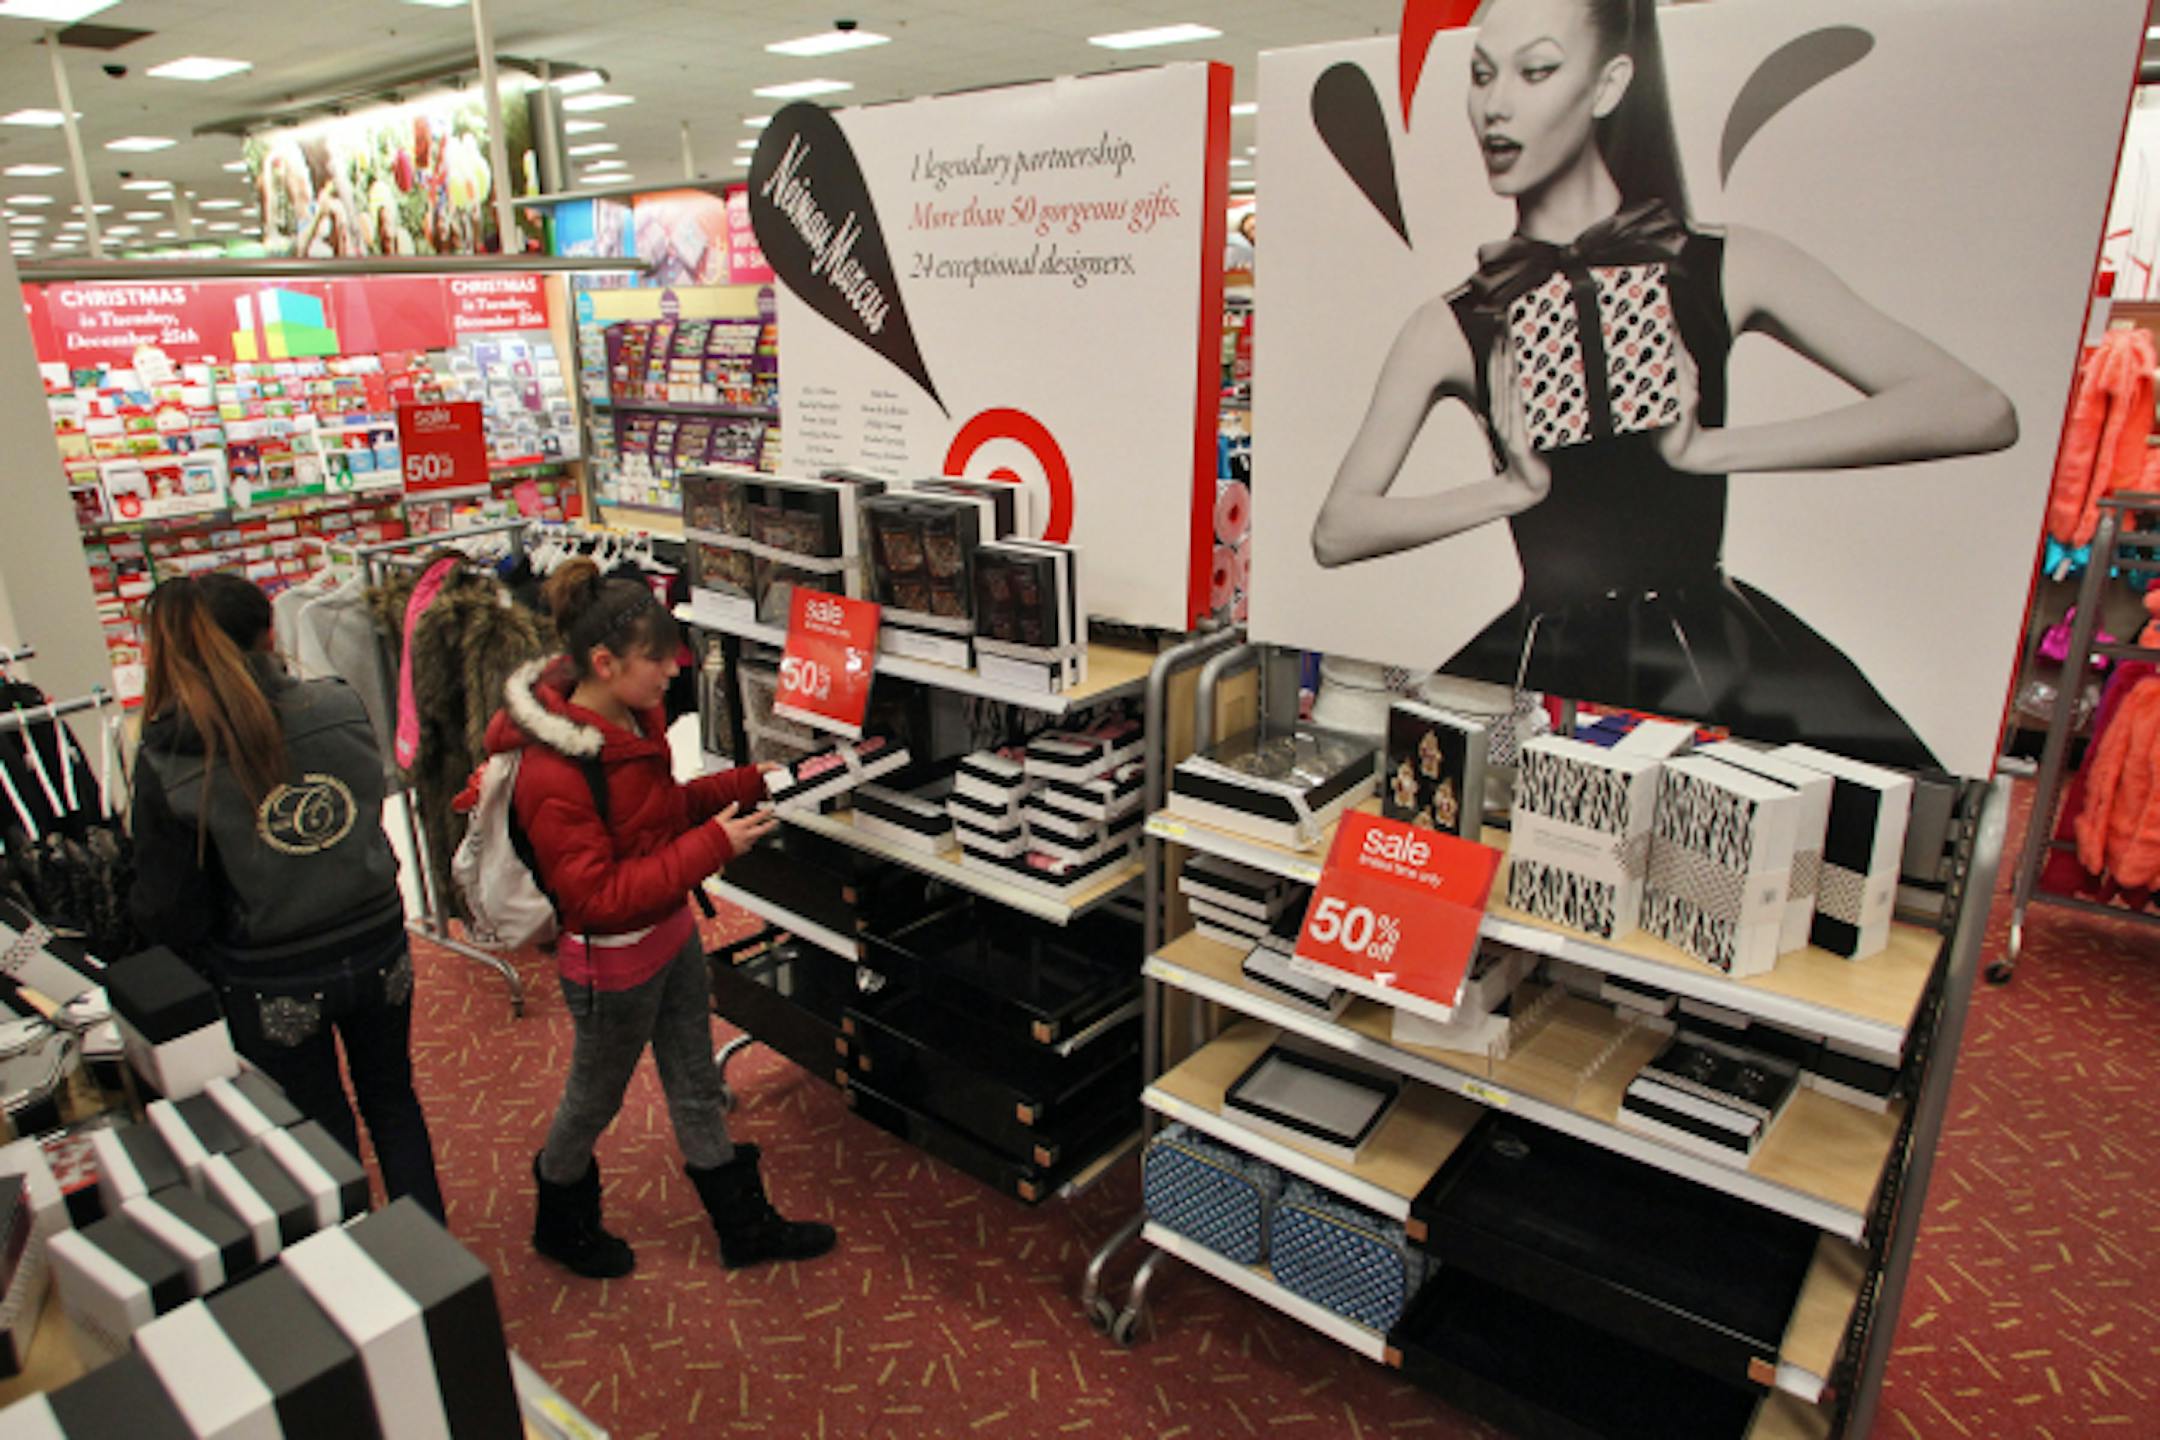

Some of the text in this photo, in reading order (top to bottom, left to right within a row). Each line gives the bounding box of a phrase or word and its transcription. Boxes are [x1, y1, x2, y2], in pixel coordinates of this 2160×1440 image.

[924, 143, 1012, 192] legendary
[1009, 130, 1136, 186] partnership.
[907, 181, 1181, 237] More than 50 gorgeous gifts.
[760, 132, 835, 257] Neiman
[811, 210, 891, 335] Marcus
[909, 242, 1137, 289] 24 exceptional designers.
[60, 287, 187, 308] CHRISTMAS
[450, 276, 537, 296] CHRISTMAS
[78, 308, 180, 328] is Tuesday,
[66, 326, 199, 350] December 25th
[805, 599, 844, 626] sale
[1362, 828, 1432, 866] sale
[1418, 871, 1445, 890] only
[1366, 942, 1396, 963] off
